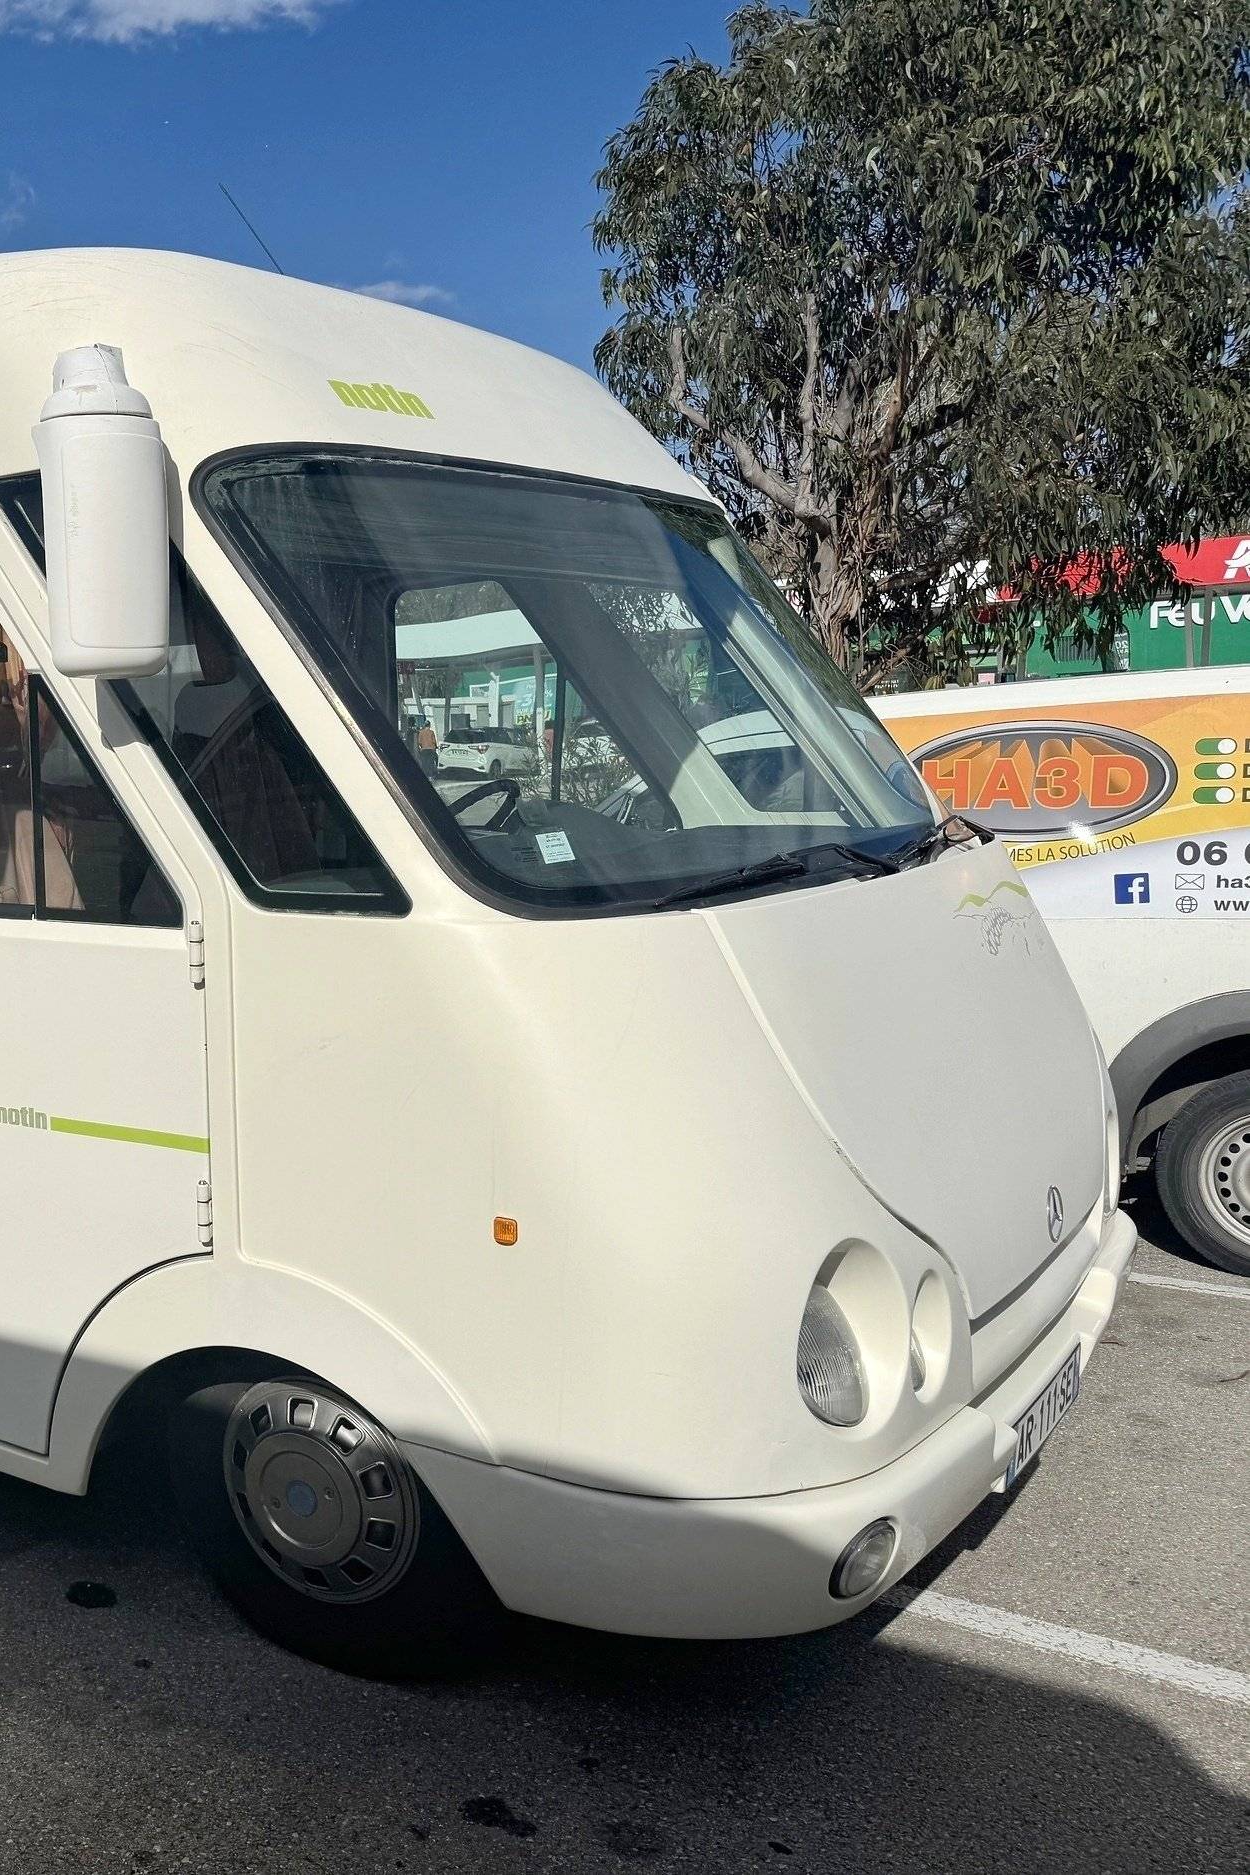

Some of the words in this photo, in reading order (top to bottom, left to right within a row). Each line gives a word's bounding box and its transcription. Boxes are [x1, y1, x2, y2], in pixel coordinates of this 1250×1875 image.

[1220, 594, 1250, 624] V
[922, 755, 1149, 810] HA3D
[1037, 847, 1056, 862] LA
[1059, 831, 1137, 861] SOLUTION
[1176, 840, 1228, 866] 06
